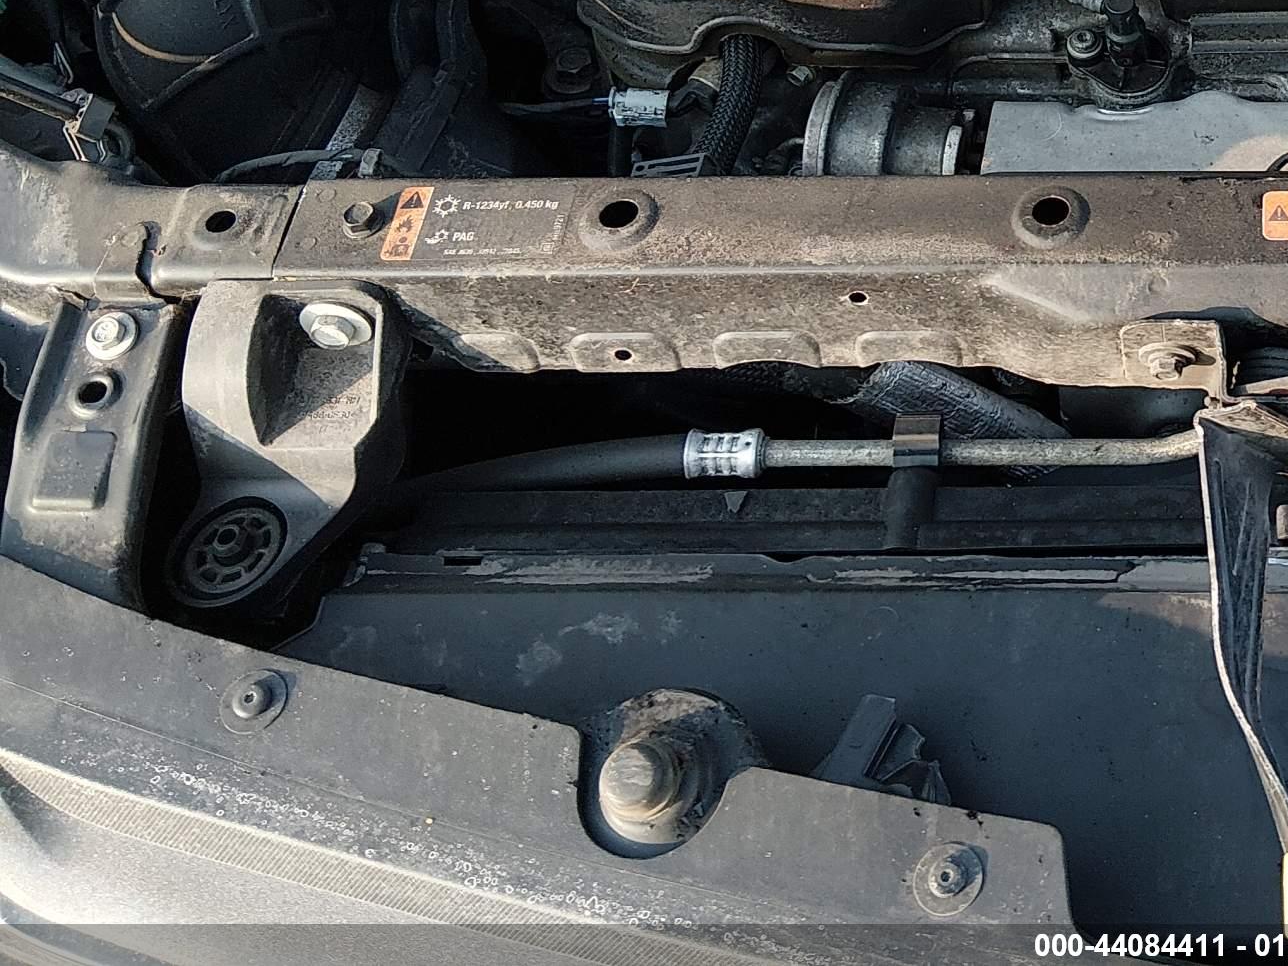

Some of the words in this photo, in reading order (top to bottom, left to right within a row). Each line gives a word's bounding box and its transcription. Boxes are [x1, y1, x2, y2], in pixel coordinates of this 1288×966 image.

[515, 200, 545, 209] 0.450
[545, 199, 559, 211] kg
[452, 231, 475, 242] PAG
